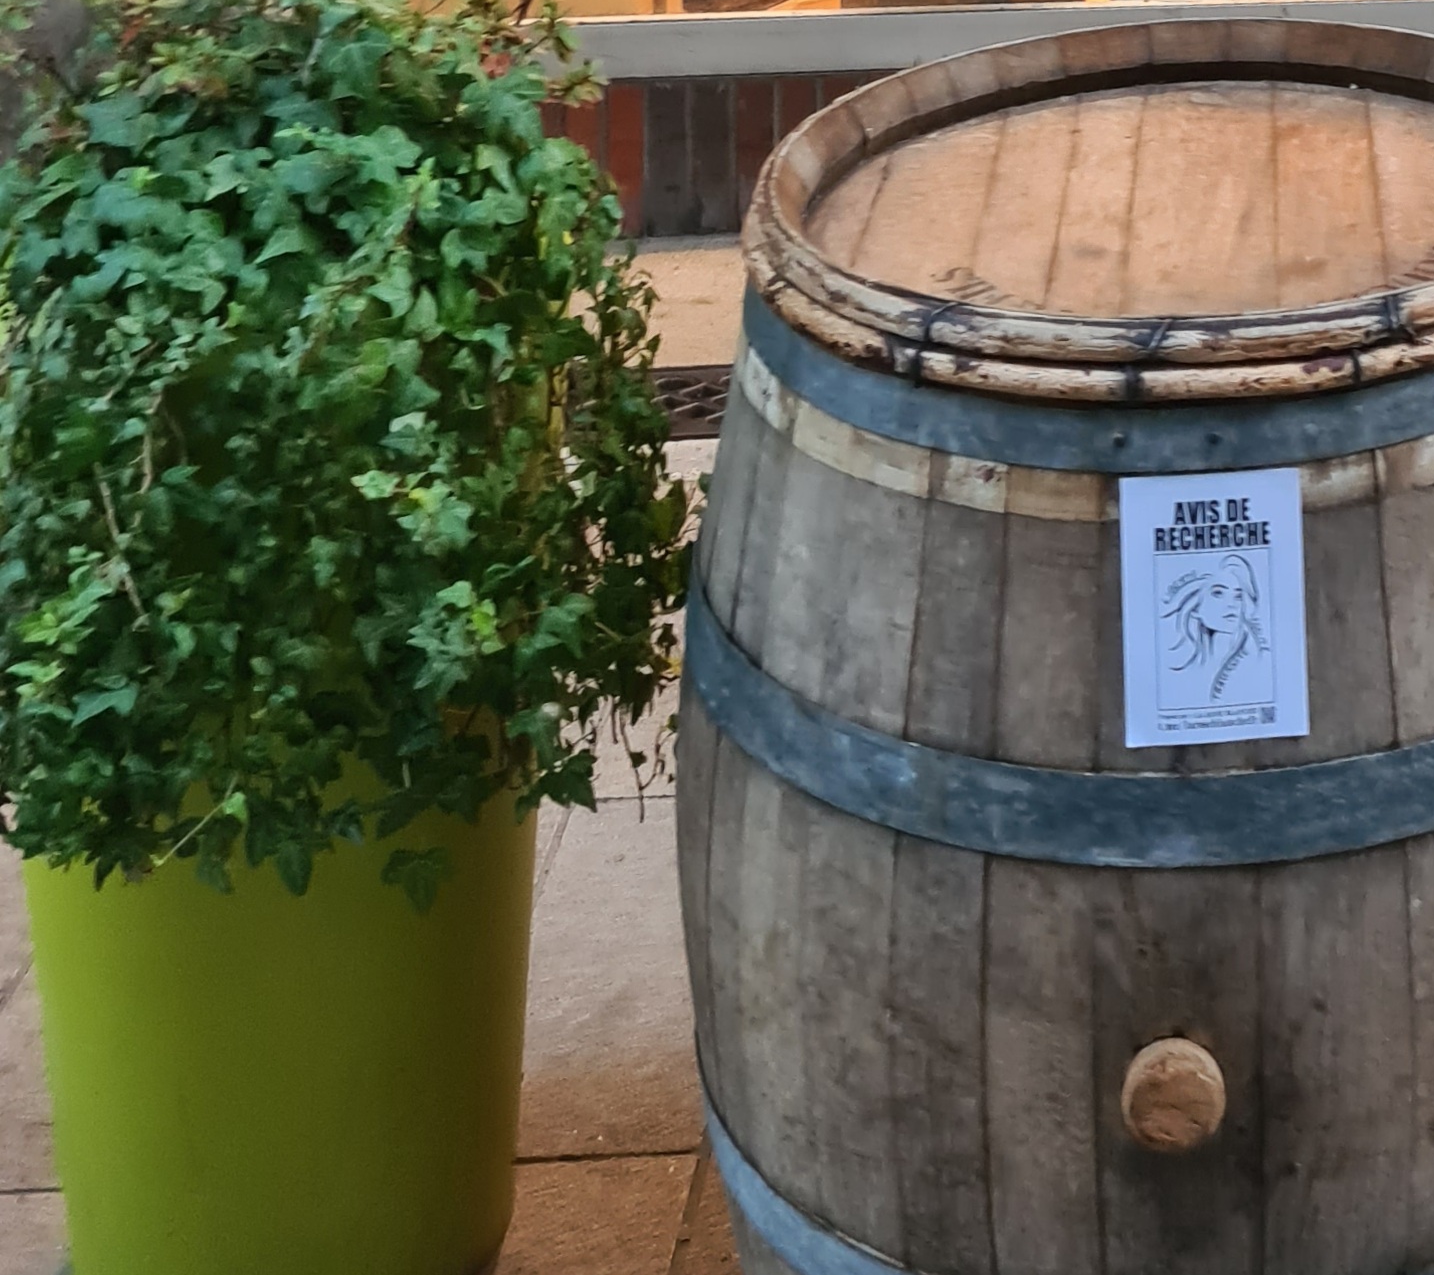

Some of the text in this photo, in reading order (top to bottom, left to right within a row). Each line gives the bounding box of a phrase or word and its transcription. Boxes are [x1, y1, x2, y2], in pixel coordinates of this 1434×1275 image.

[1174, 498, 1251, 526] AVIS DE
[1154, 521, 1271, 551] RECHERCHE
